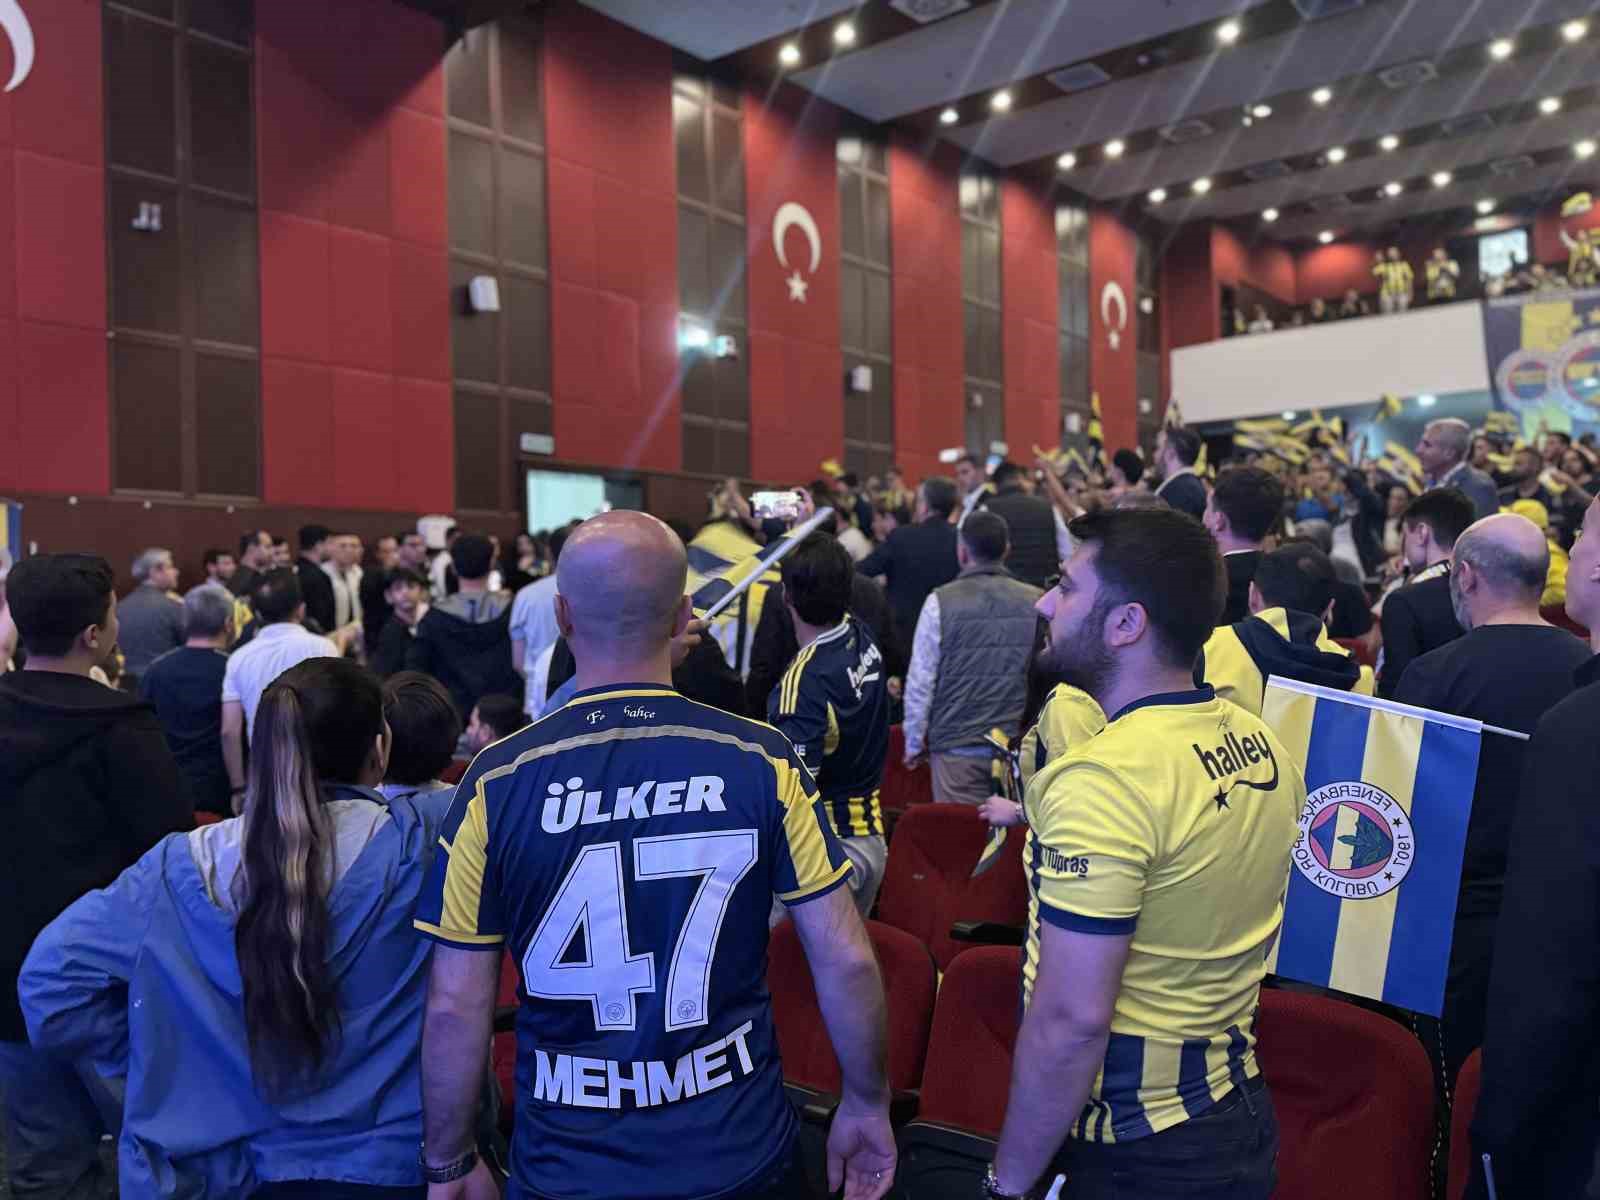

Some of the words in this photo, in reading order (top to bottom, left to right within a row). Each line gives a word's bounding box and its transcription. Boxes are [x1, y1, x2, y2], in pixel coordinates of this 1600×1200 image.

[1192, 730, 1279, 791] halley
[541, 776, 727, 834] ÜLKER
[522, 829, 758, 1032] 47
[533, 1021, 754, 1108] MEHMET
